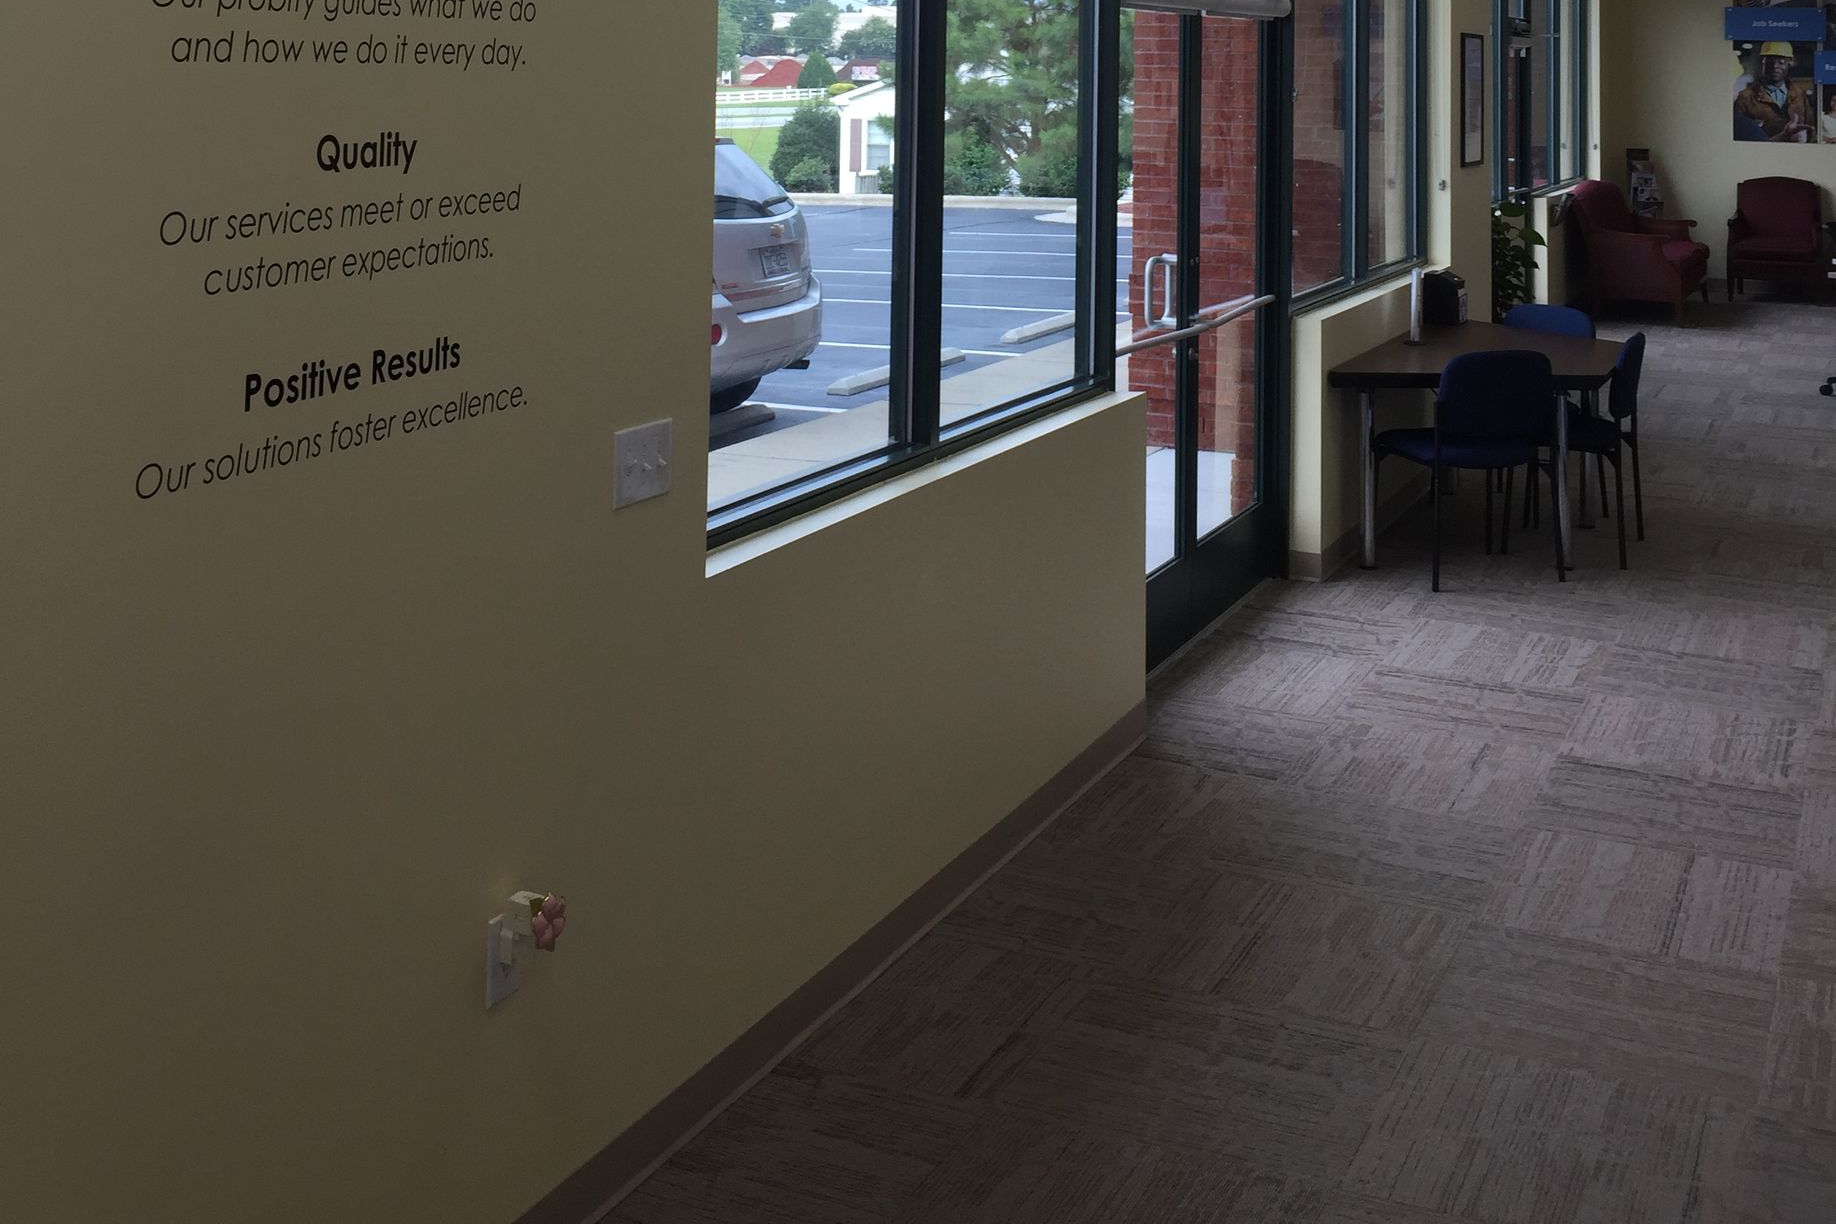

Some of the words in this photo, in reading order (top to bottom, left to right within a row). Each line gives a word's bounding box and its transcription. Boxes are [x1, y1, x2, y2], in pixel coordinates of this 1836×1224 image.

[471, 0, 503, 22] we
[1752, 20, 1767, 28] Job
[1768, 20, 1799, 28] Seekers
[170, 30, 235, 64] and
[242, 30, 305, 64] how
[312, 40, 349, 64] we
[356, 33, 388, 65] do
[394, 34, 409, 65] it
[414, 42, 477, 72] every
[481, 37, 526, 72] day.
[316, 131, 418, 175] Quality
[159, 210, 220, 247] Our
[224, 201, 334, 240] services
[339, 192, 405, 229] meet
[409, 196, 434, 221] or
[438, 183, 522, 218] exceed
[203, 256, 337, 296] customer
[341, 234, 494, 281] expectations.
[244, 359, 362, 413] Positive
[371, 335, 461, 386] Results
[135, 461, 197, 500] Our
[202, 432, 323, 485] solutions
[329, 412, 397, 454] foster
[402, 390, 528, 434] excellence.
